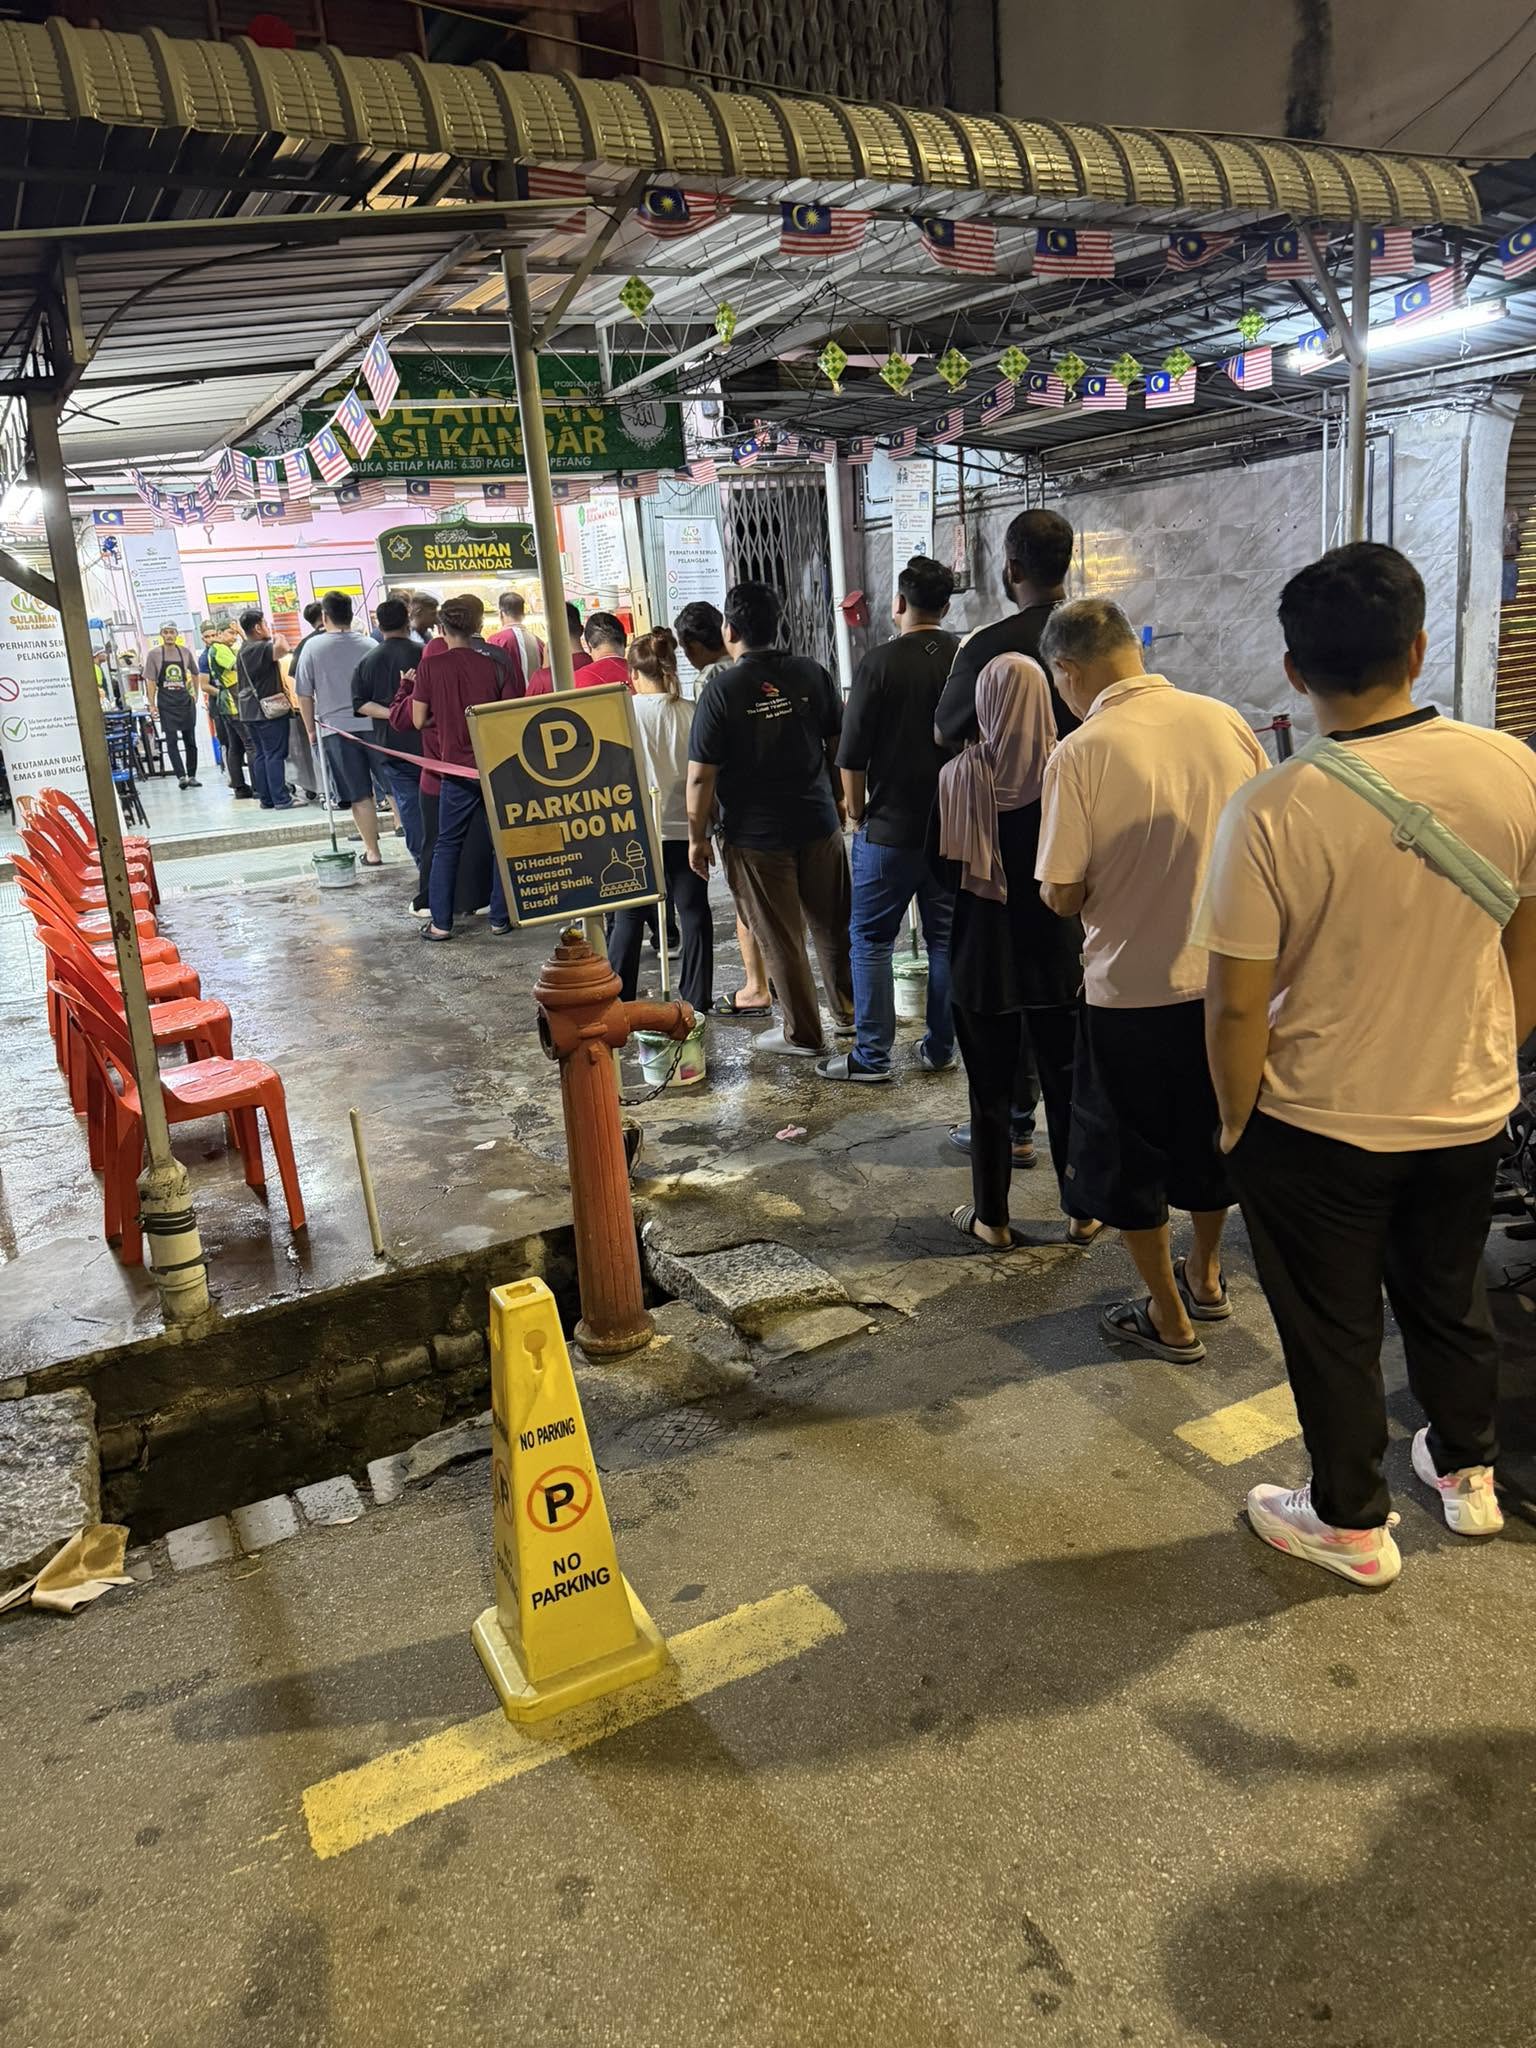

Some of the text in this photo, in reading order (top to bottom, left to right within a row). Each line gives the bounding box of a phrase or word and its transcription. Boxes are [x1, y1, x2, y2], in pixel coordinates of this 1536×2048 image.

[440, 425, 608, 457] KANAR
[352, 461, 384, 473] BUKA
[387, 460, 424, 472] SETIAP
[427, 459, 457, 470] HARI:
[486, 458, 514, 469] PAGI
[550, 456, 592, 467] PETANG
[424, 543, 511, 559] SULAIMAN
[427, 558, 513, 571] NASI KANDAR
[0, 640, 47, 651] PERHATIAN
[539, 720, 578, 770] P
[11, 754, 82, 771] KEUTAMAAN BUAT
[13, 770, 37, 782] EMAS
[38, 770, 43, 779] &
[44, 768, 58, 778] IBU
[504, 783, 634, 826] PARKING
[558, 809, 637, 843] 100 M
[514, 851, 583, 872] Di Hadapan
[517, 866, 573, 885] Kawasan
[520, 875, 594, 899] Masjid Shaik
[522, 895, 560, 911] Eusoff
[519, 1426, 536, 1452] NO
[536, 1417, 577, 1446] PARKING
[544, 1481, 575, 1524] P
[552, 1551, 582, 1577] NO
[531, 1566, 611, 1611] PARKING
